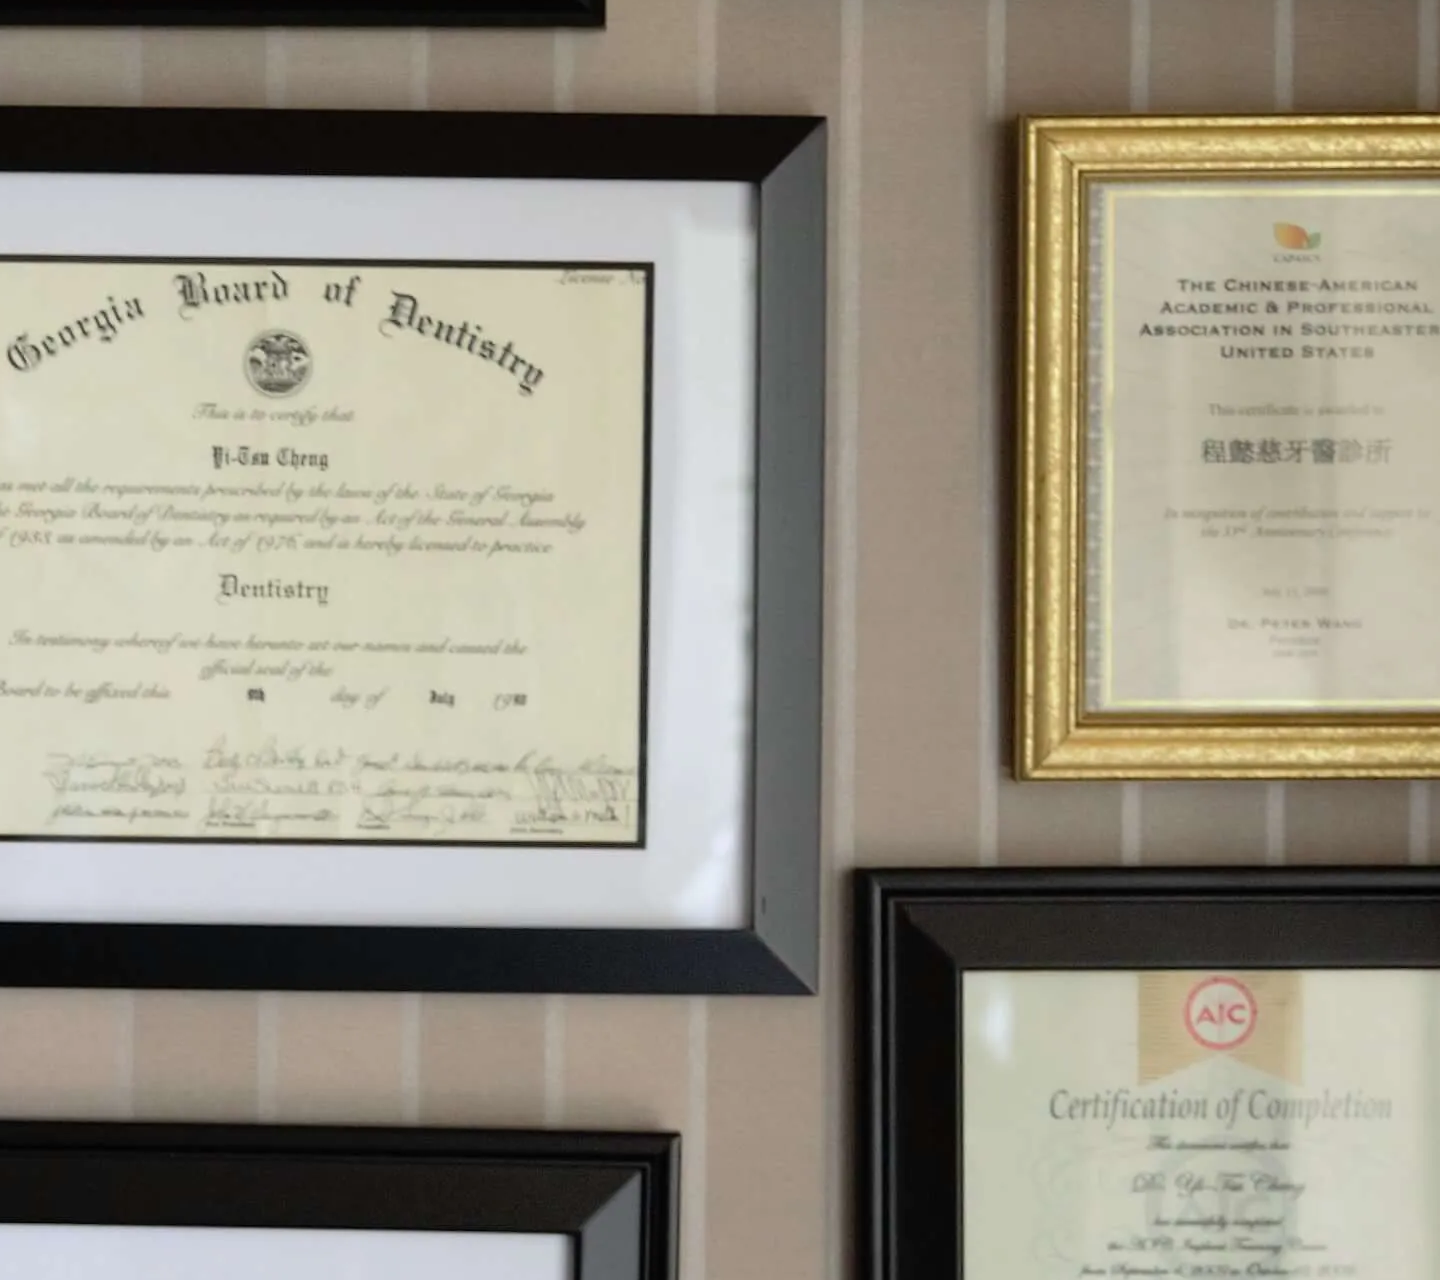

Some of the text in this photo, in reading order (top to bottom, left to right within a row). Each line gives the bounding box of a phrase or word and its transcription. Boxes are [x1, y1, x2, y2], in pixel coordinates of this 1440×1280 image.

[1176, 279, 1216, 293] THE
[1159, 300, 1434, 315] ACADEMIC & PROFESSIONAL
[6, 271, 544, 396] Georgia Board of Dentistry
[1138, 323, 1265, 337] ASSOCIATION
[1272, 324, 1291, 337] IN
[1220, 345, 1374, 360] UNITED STATES
[277, 445, 330, 471] Cheng
[215, 573, 330, 607] Dentistry
[1196, 1003, 1247, 1025] AIC
[1049, 1088, 1393, 1129] Certification of Completion
